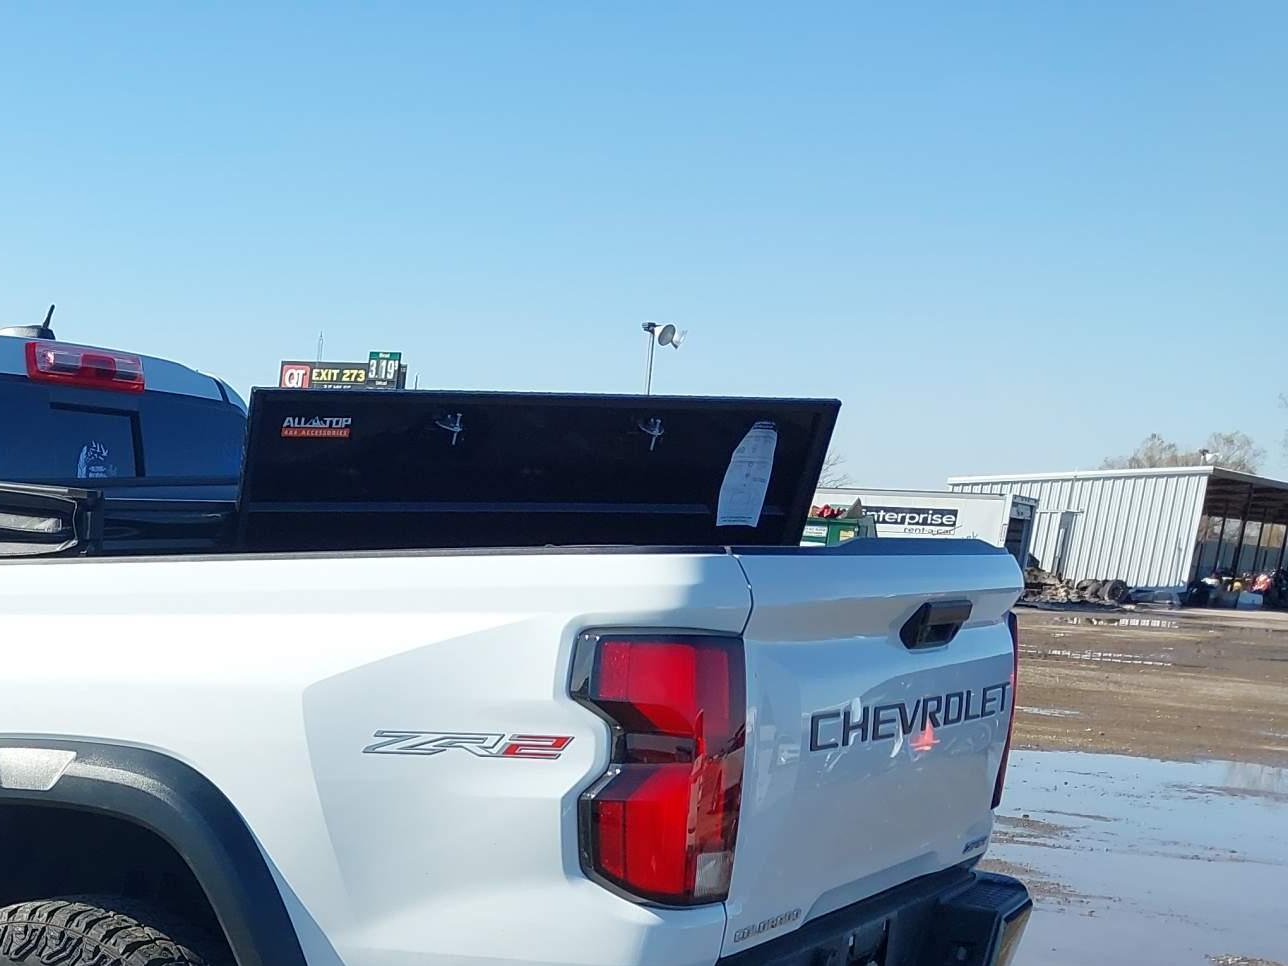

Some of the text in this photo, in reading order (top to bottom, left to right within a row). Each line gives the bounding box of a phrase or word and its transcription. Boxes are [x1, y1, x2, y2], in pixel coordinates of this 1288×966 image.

[312, 368, 366, 382] EXIT 273
[809, 681, 1012, 752] CHEVROLET
[362, 730, 575, 760] ZR2
[733, 908, 803, 943] COLORADO
